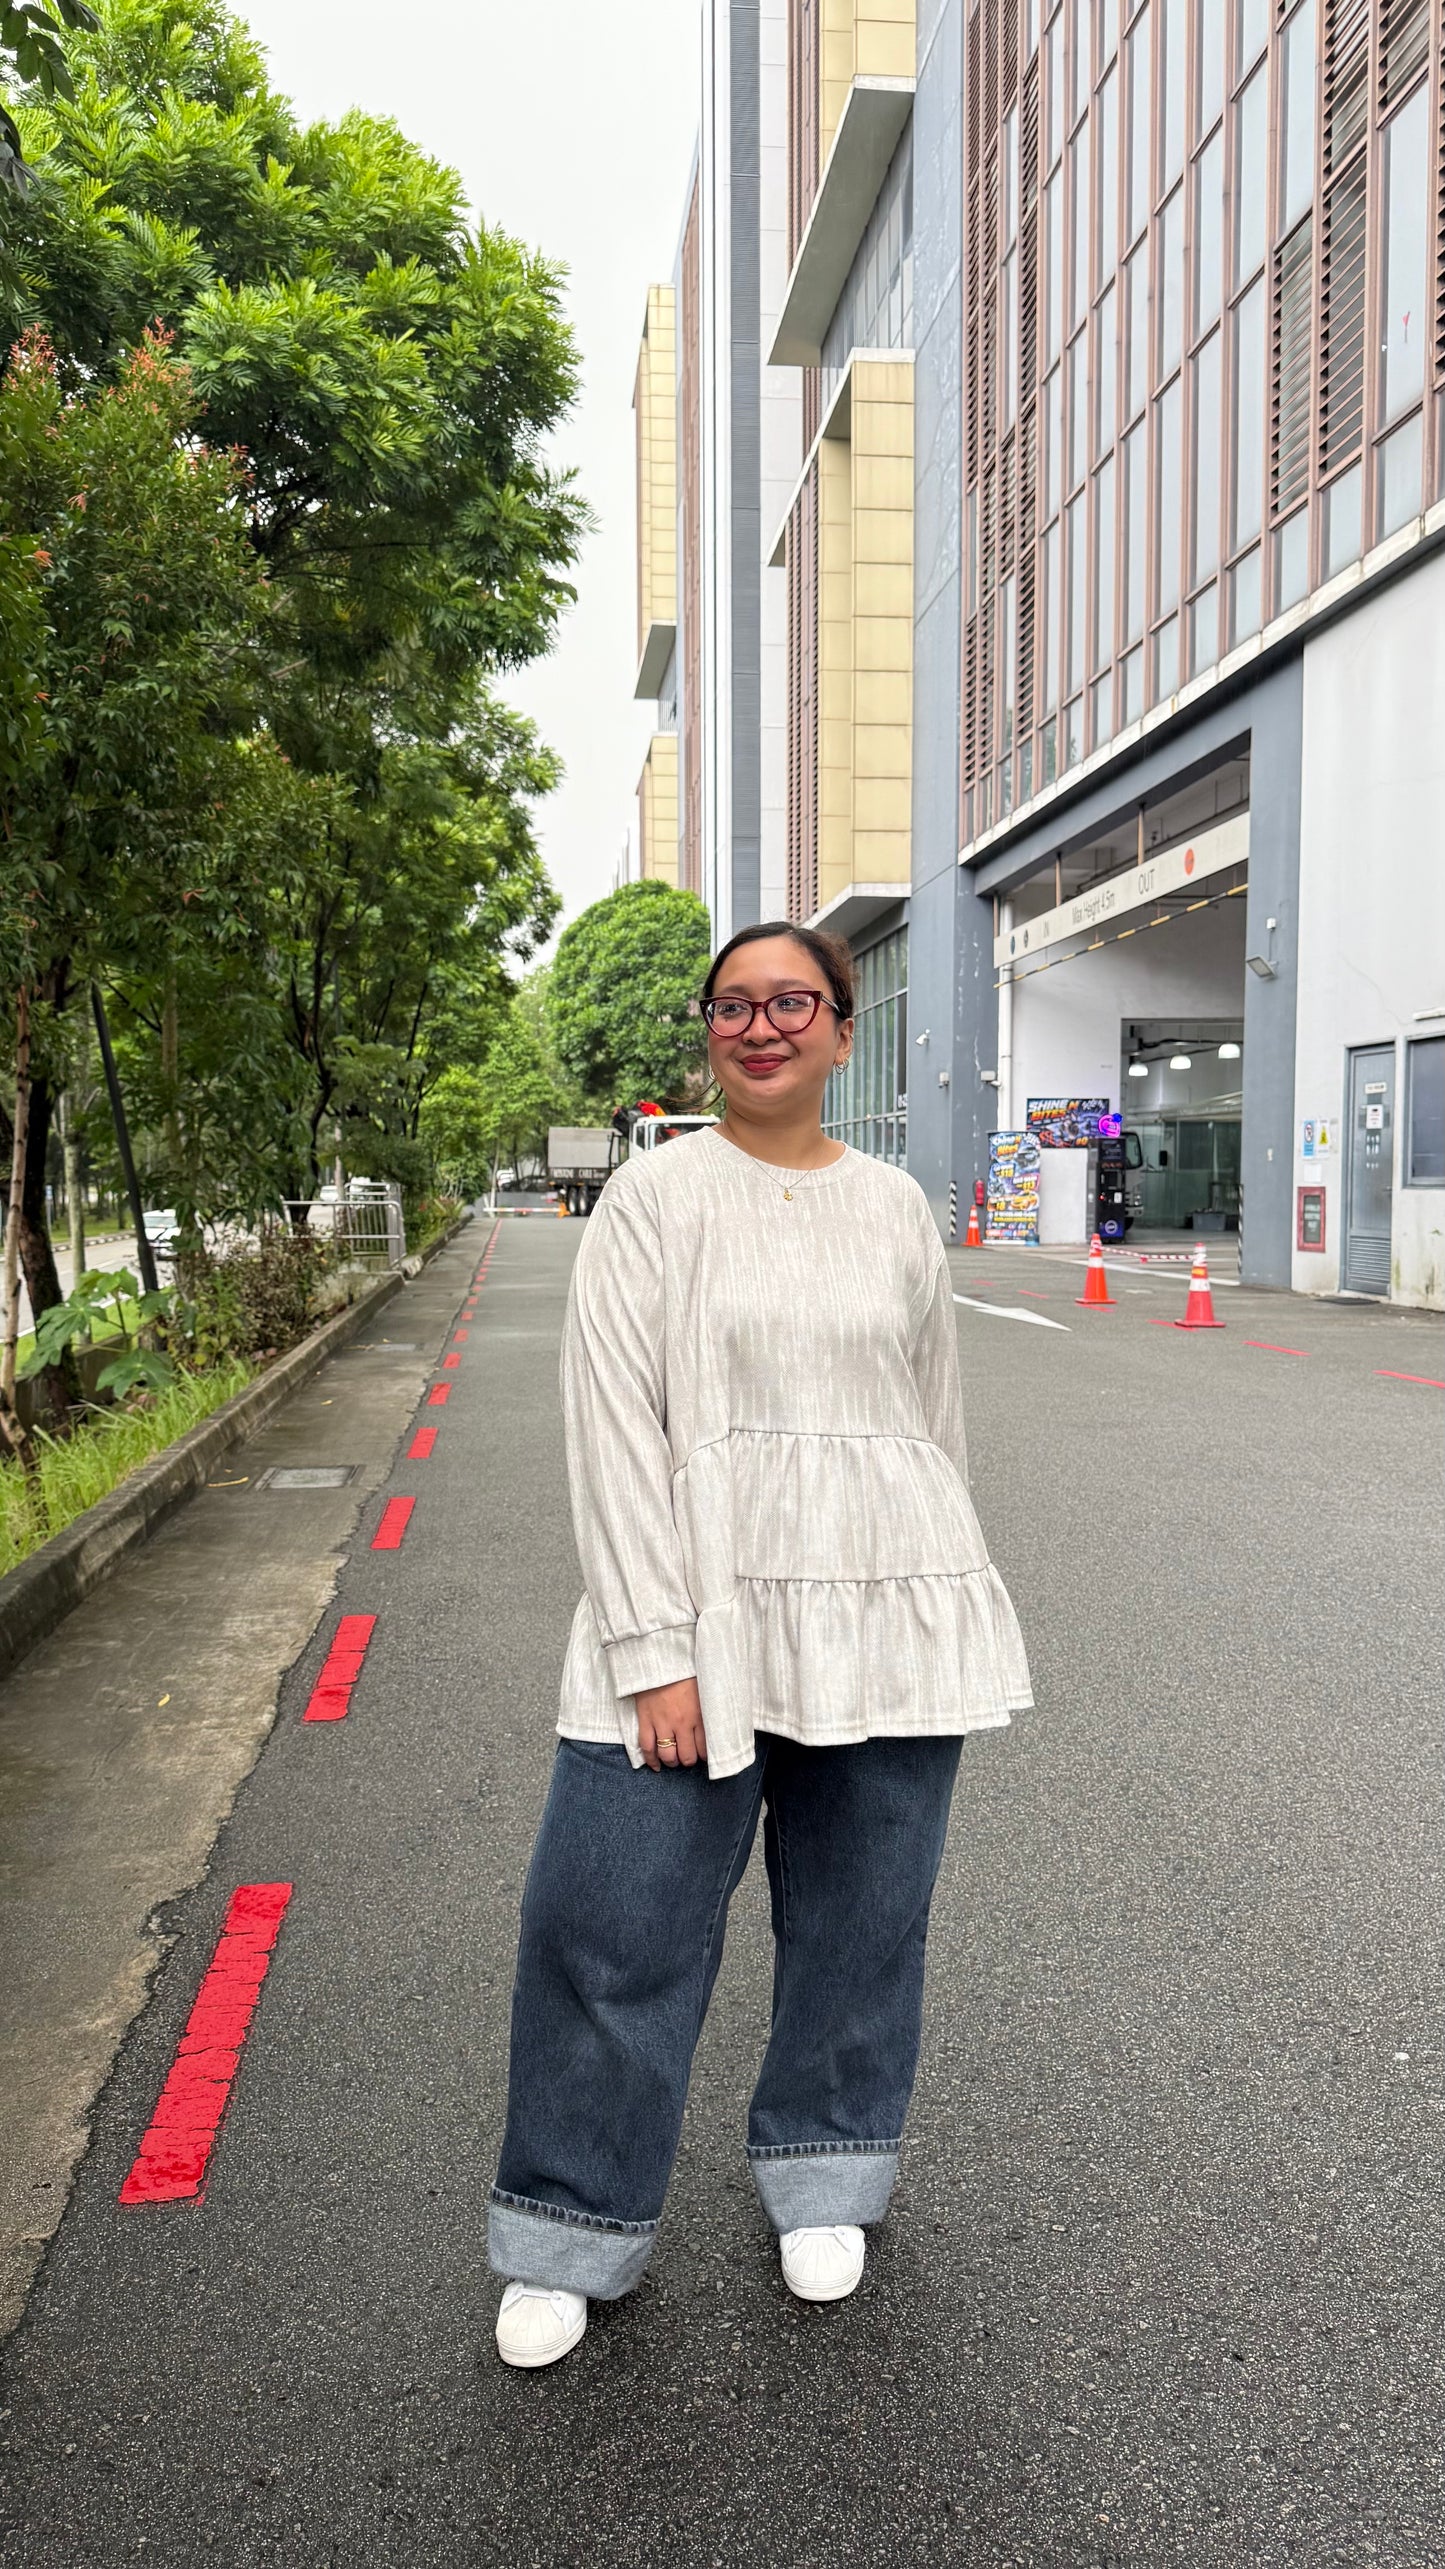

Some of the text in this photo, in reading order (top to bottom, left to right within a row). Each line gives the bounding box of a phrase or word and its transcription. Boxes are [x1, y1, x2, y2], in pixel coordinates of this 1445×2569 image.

[1138, 868, 1155, 895] OUT
[1072, 889, 1115, 925] Max Height 4.5m
[1028, 1100, 1080, 1112] SHINE N
[1030, 1109, 1067, 1121] BITES
